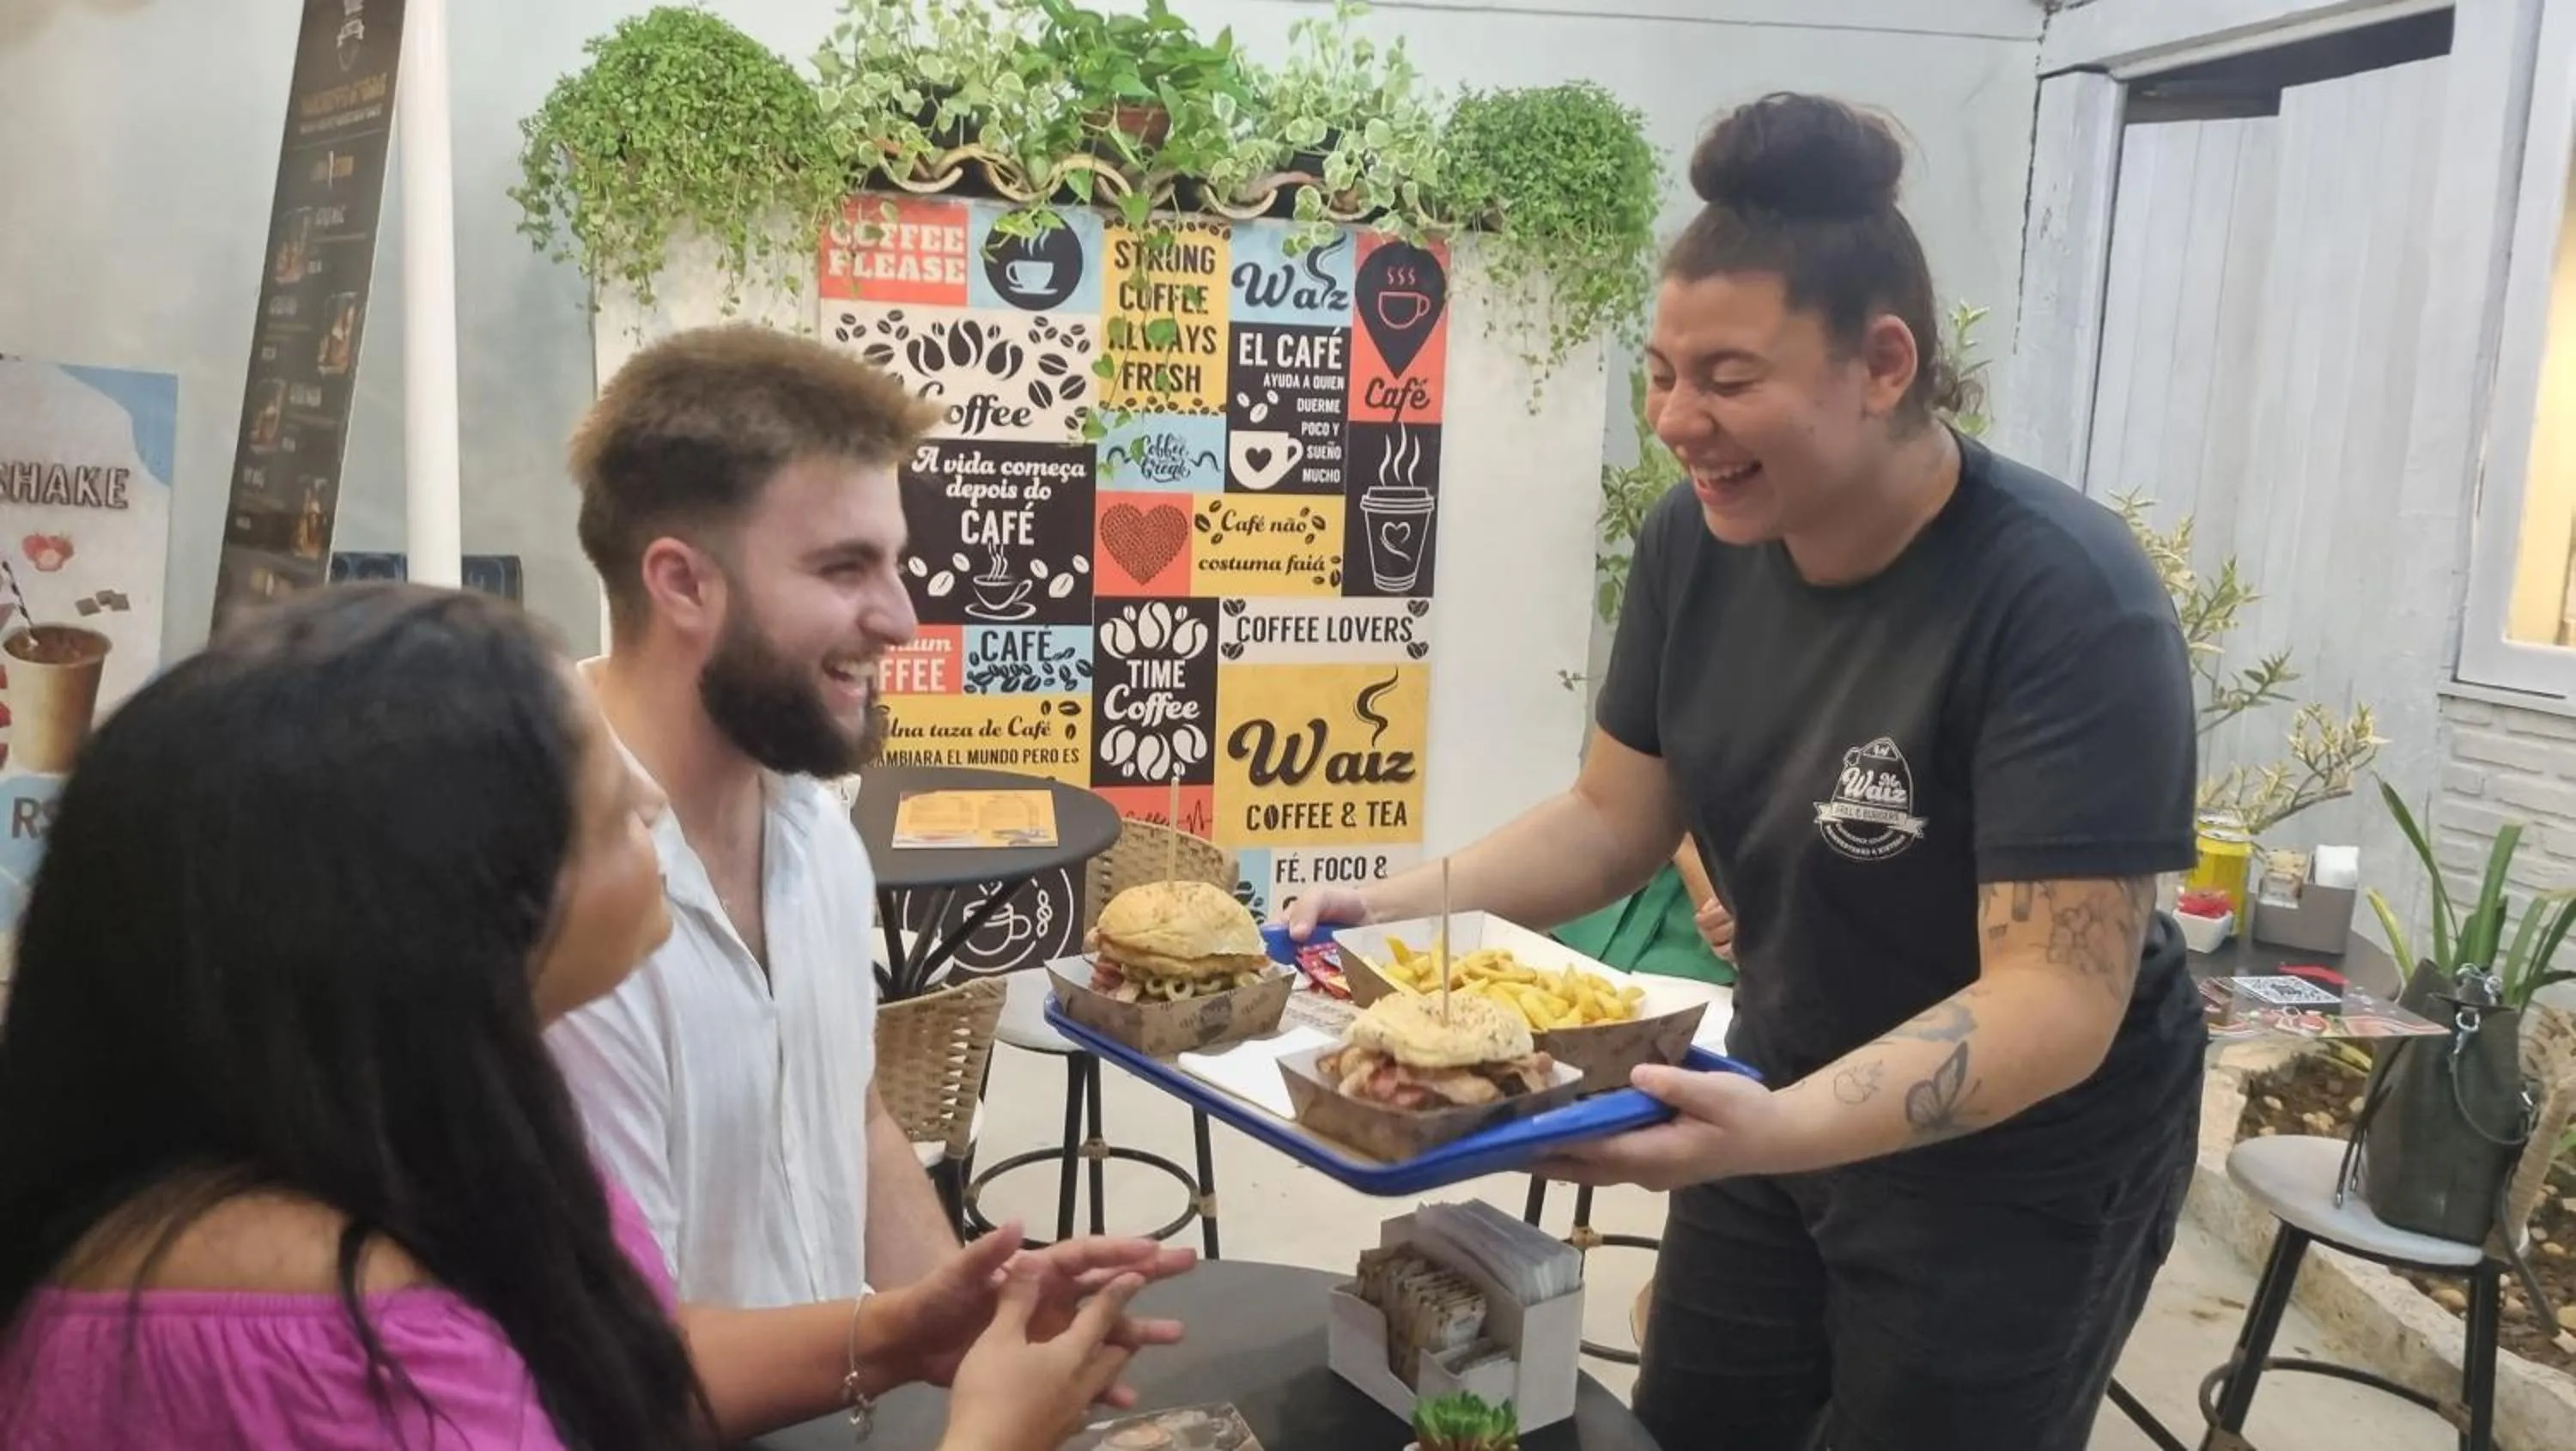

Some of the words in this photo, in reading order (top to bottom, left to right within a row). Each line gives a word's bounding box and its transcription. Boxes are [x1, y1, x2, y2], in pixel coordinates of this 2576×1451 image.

[829, 219, 963, 254] COFFEE
[828, 249, 966, 284] PLEASE
[1114, 240, 1217, 275] STRONG
[1109, 320, 1218, 355] LAYS
[1239, 332, 1268, 367] EL
[1277, 327, 1343, 370] CAFÉ
[1263, 373, 1300, 388] AYUDA
[1303, 375, 1310, 389] A
[1297, 398, 1341, 414] DUERME
[1364, 378, 1431, 422] Café
[1301, 421, 1330, 437] POCO
[1333, 422, 1340, 437] Y
[912, 445, 940, 472] A
[943, 450, 997, 475] vida
[999, 460, 1086, 483] começa
[1306, 440, 1342, 459] SUEÑO
[0, 460, 130, 510] HAKE
[945, 474, 1018, 508] depois
[1023, 477, 1052, 500] do
[1302, 468, 1341, 483] MUCHO
[960, 501, 1035, 546] CAFÉ
[1221, 508, 1266, 536] Café
[1270, 517, 1307, 532] não
[1198, 556, 1282, 571] costuma
[980, 625, 1053, 663] CAFÉ
[1236, 616, 1319, 644] COFFEE
[1327, 616, 1413, 643] LOVERS
[878, 659, 947, 692] FFEE
[1127, 659, 1186, 689] TIME
[1103, 683, 1200, 727] Coffee
[929, 721, 973, 738] taza
[979, 718, 1003, 738] de
[1006, 715, 1052, 740] Café
[1227, 665, 1416, 787] Waiz
[877, 750, 943, 768] AMBIARA
[946, 749, 963, 764] EL
[967, 749, 1018, 765] MUNDO
[1022, 748, 1060, 764] PERO
[1061, 748, 1079, 763] ES
[1840, 767, 1908, 804] Waiz
[1246, 802, 1333, 831] COFFEE
[1340, 802, 1357, 828] &
[1365, 800, 1408, 827] TEA
[1313, 856, 1366, 882] FOCO
